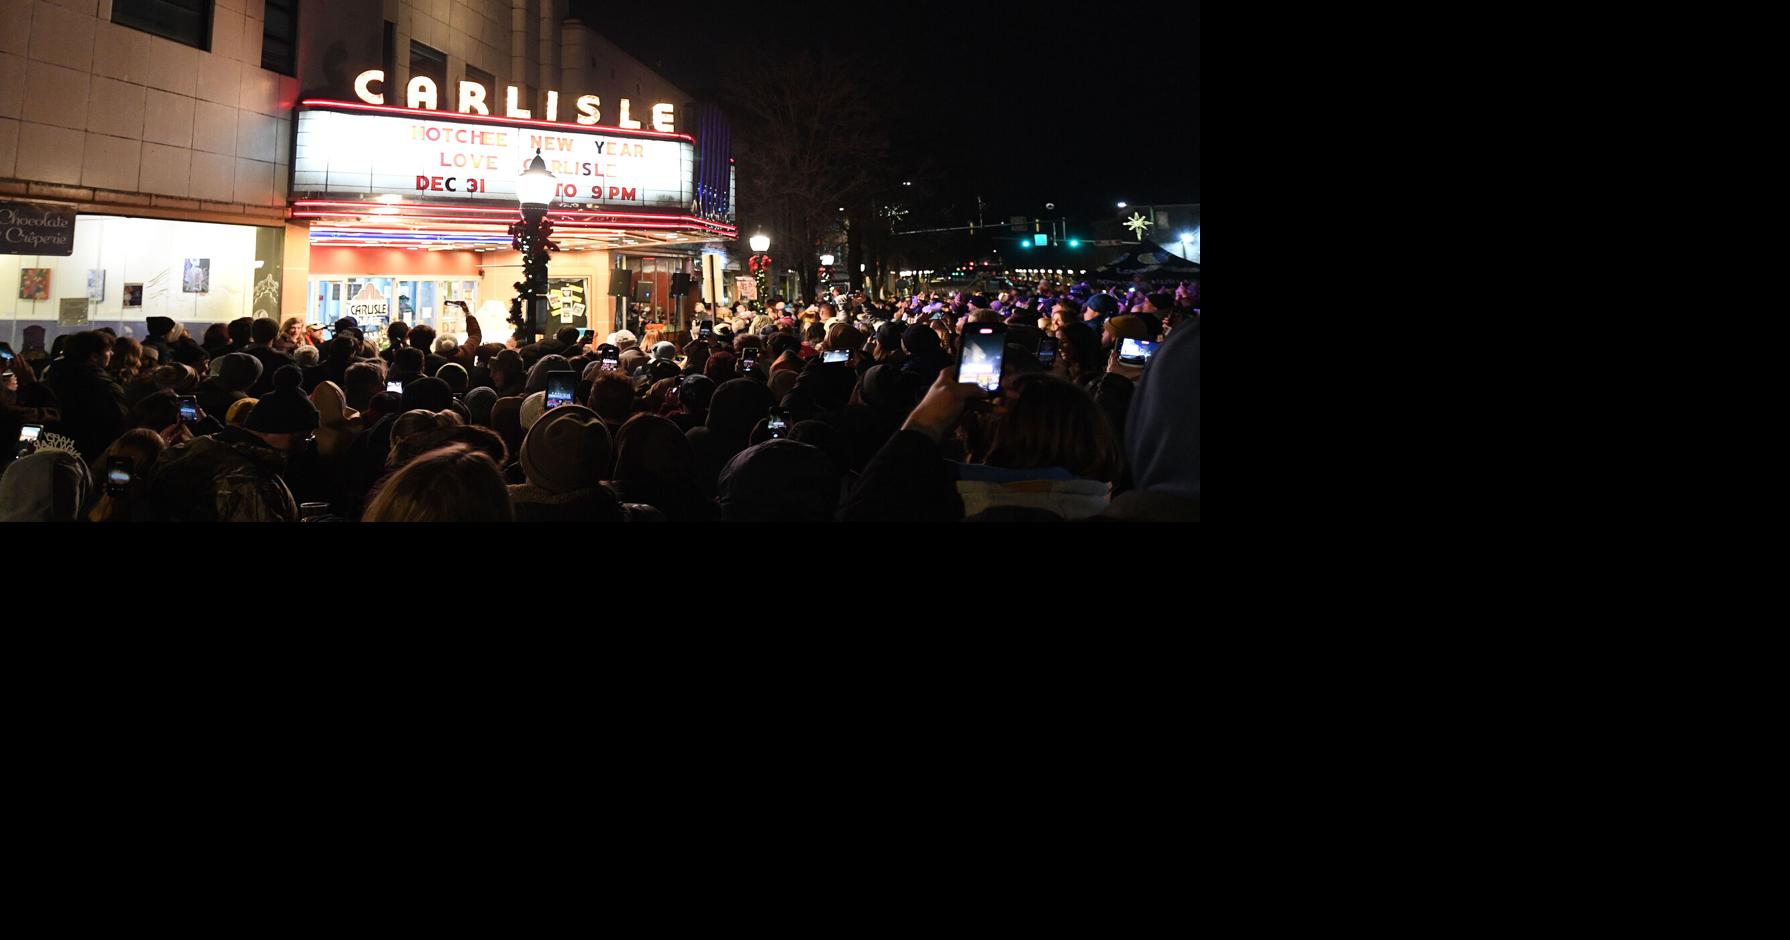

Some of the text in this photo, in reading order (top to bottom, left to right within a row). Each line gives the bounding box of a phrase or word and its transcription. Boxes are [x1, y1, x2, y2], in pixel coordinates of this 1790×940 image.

[354, 69, 674, 133] CARLISLE
[530, 135, 574, 152] NEW
[594, 140, 645, 158] YEAR
[439, 152, 617, 177] LOVE CRLISLE
[416, 175, 637, 201] DEC 31 TO 9 PM
[0, 209, 69, 228] Chocolate
[5, 227, 66, 248] Crêperie
[350, 304, 386, 315] CARLISLE
